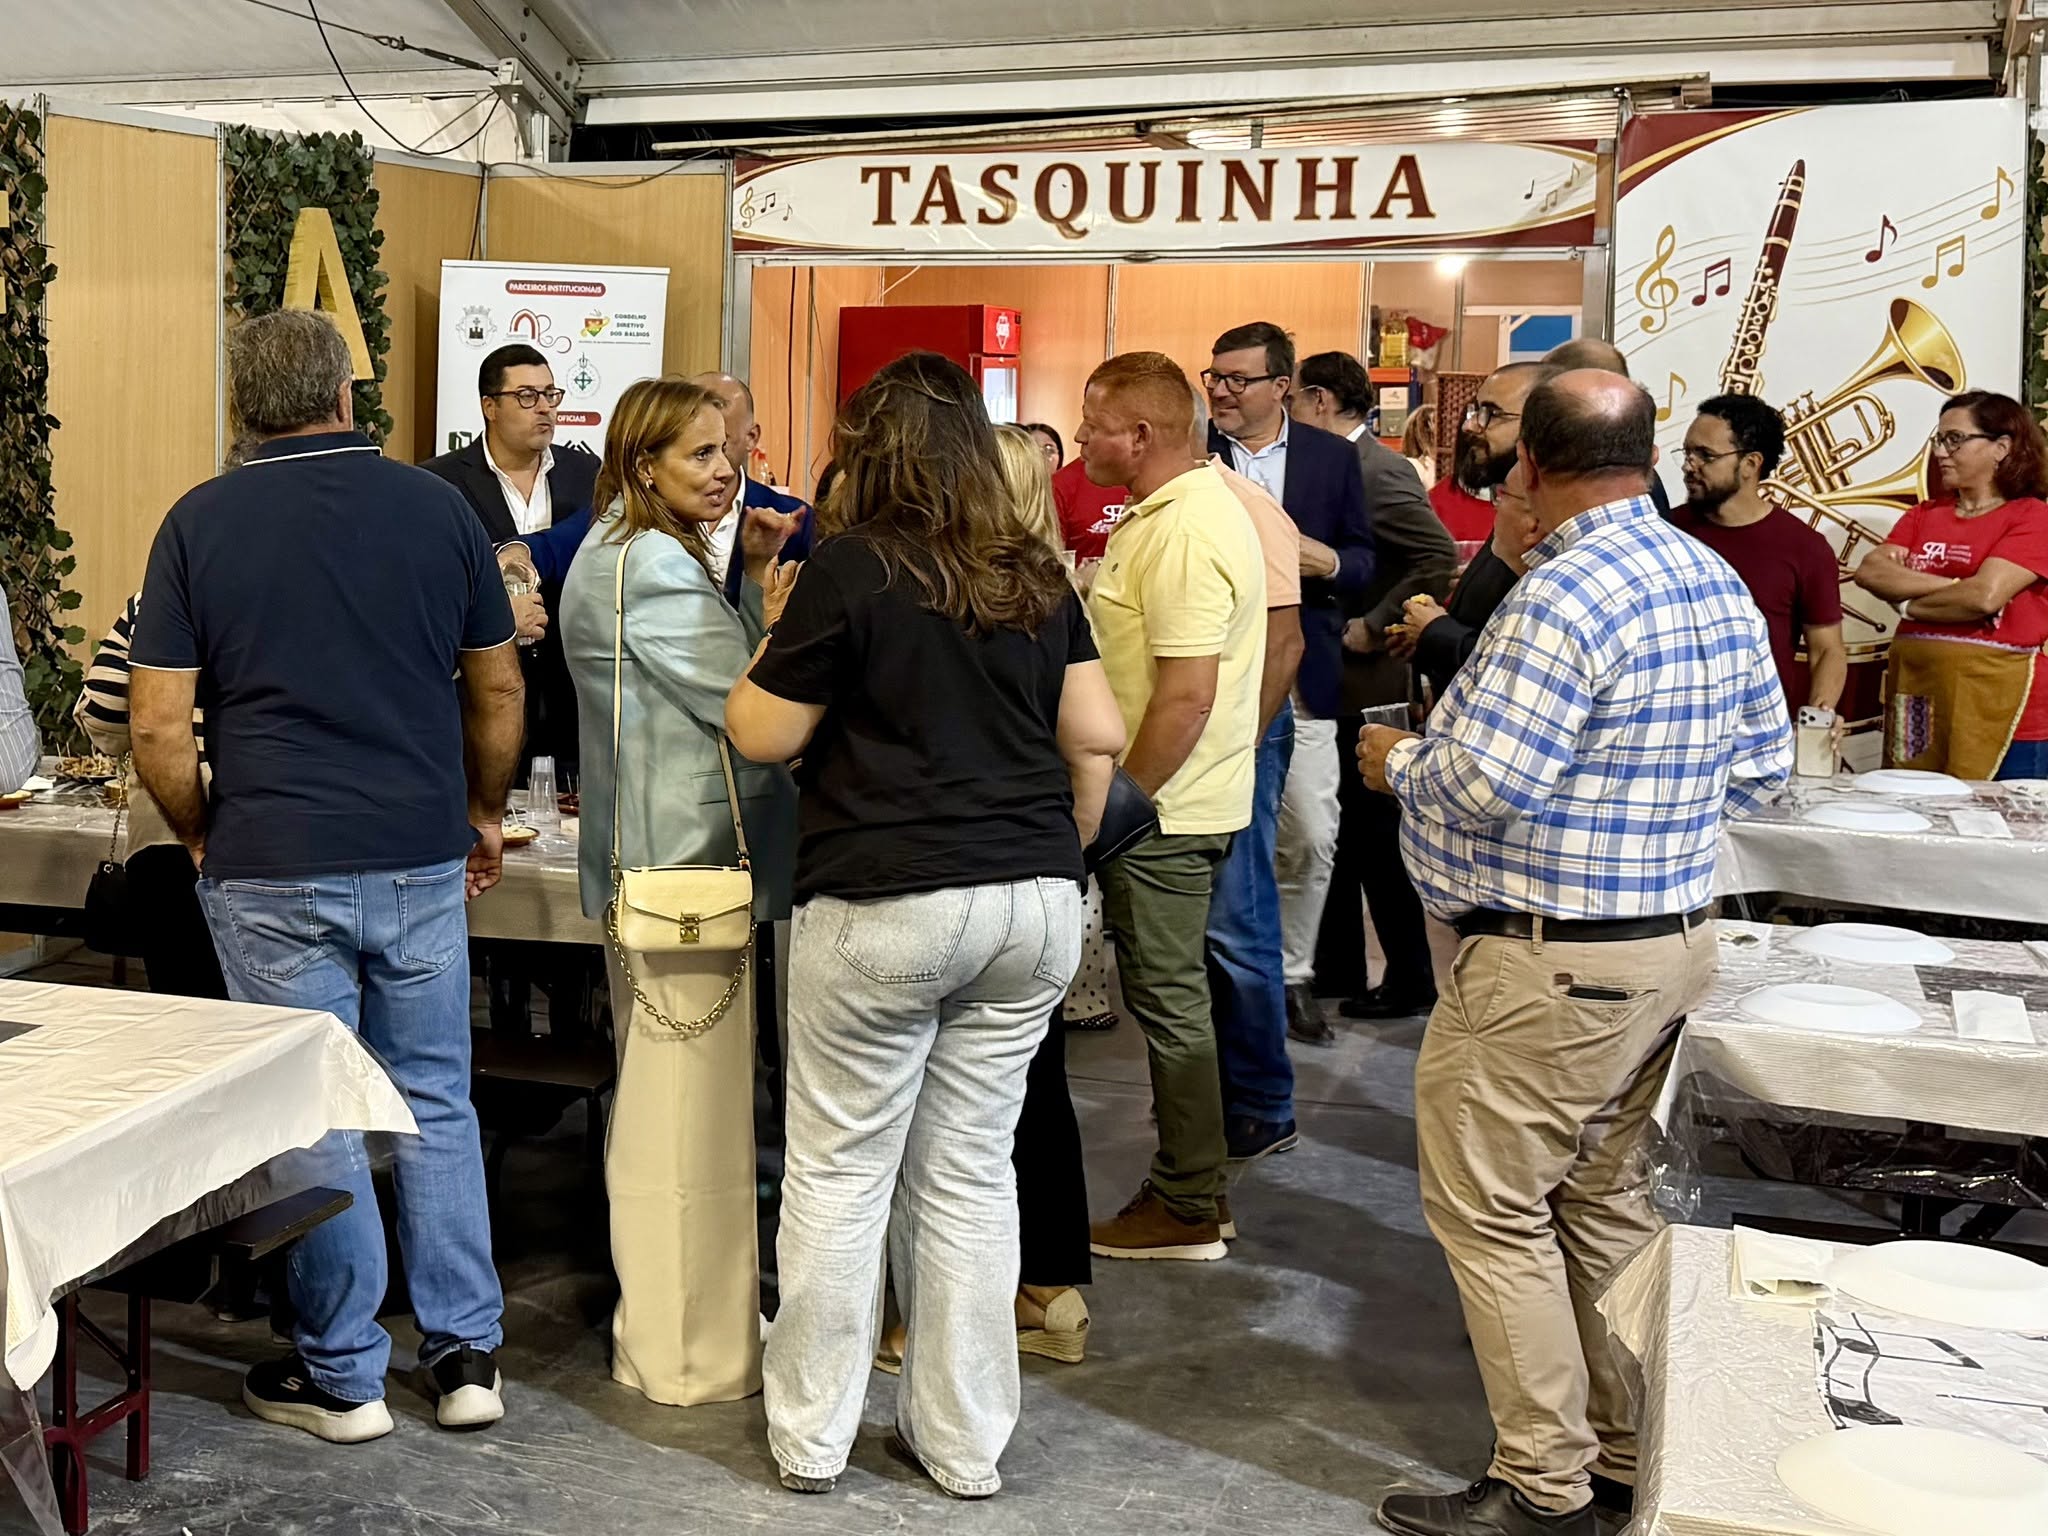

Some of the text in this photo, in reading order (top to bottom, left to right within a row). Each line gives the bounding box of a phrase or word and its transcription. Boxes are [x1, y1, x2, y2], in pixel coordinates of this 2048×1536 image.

[860, 154, 1436, 240] TASQUINHA
[282, 207, 374, 380] A
[509, 283, 602, 294] PARCEIROS INSTITUCIONAIS
[557, 414, 586, 423] OFICIAIS
